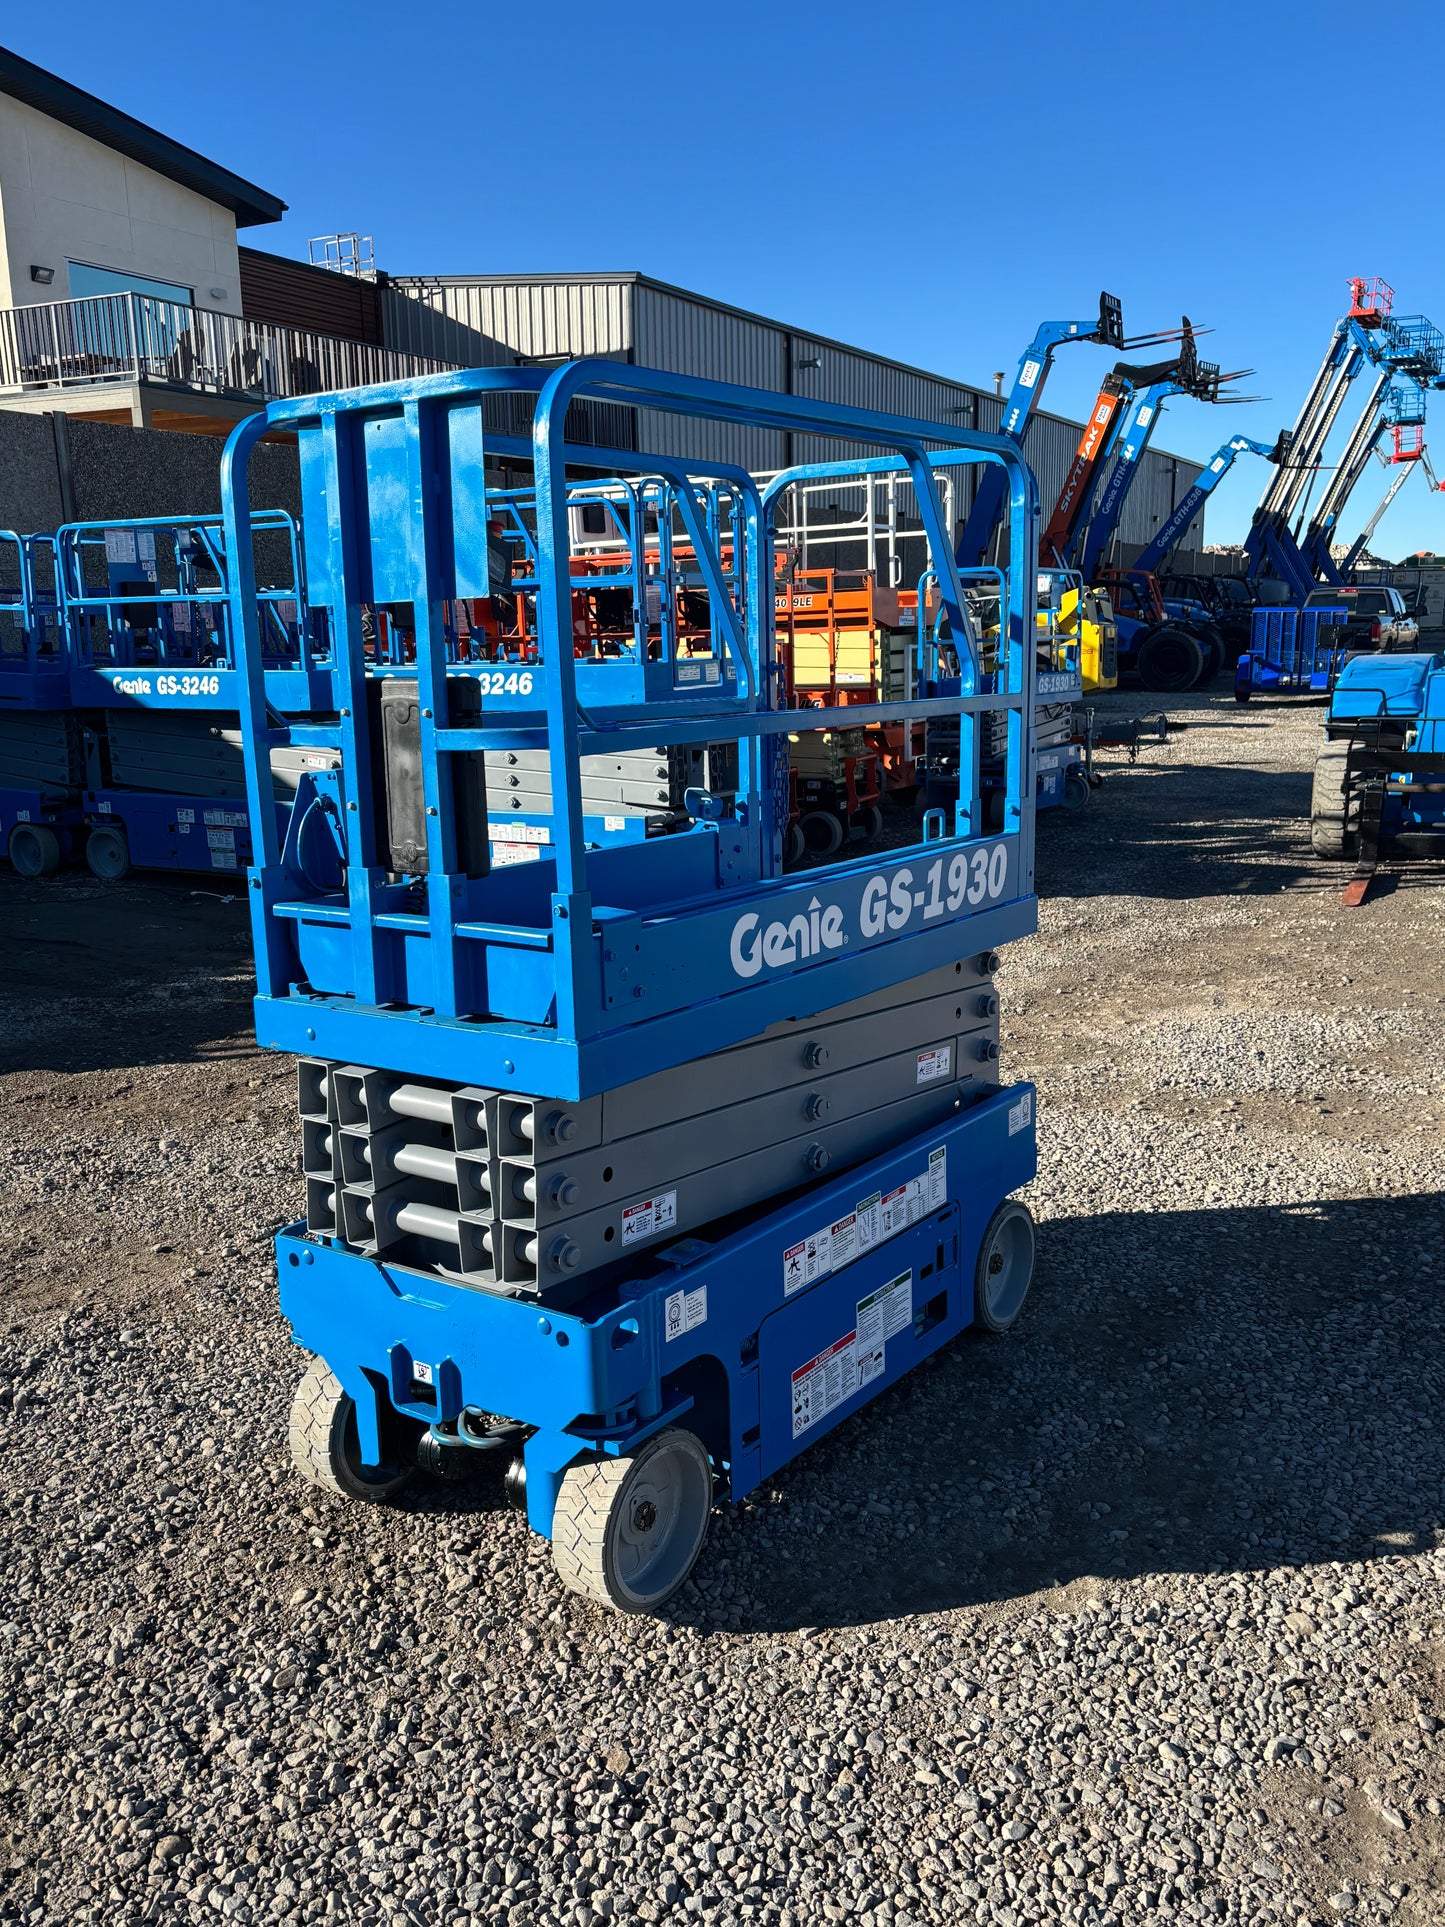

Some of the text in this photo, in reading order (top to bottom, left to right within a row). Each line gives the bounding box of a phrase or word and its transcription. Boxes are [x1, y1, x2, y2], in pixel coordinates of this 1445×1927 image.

[1005, 408, 1020, 438] TH-844
[1060, 425, 1099, 513] SKYTRAK
[1102, 444, 1135, 515] Genie GTH-844
[1157, 488, 1202, 547] Genie GTH-636
[775, 597, 812, 608] 409LE
[112, 675, 219, 695] Genie GS-3246
[1038, 675, 1069, 694] GS-1930
[859, 843, 1008, 938] GS-1930
[838, 1216, 855, 1231] DANGER
